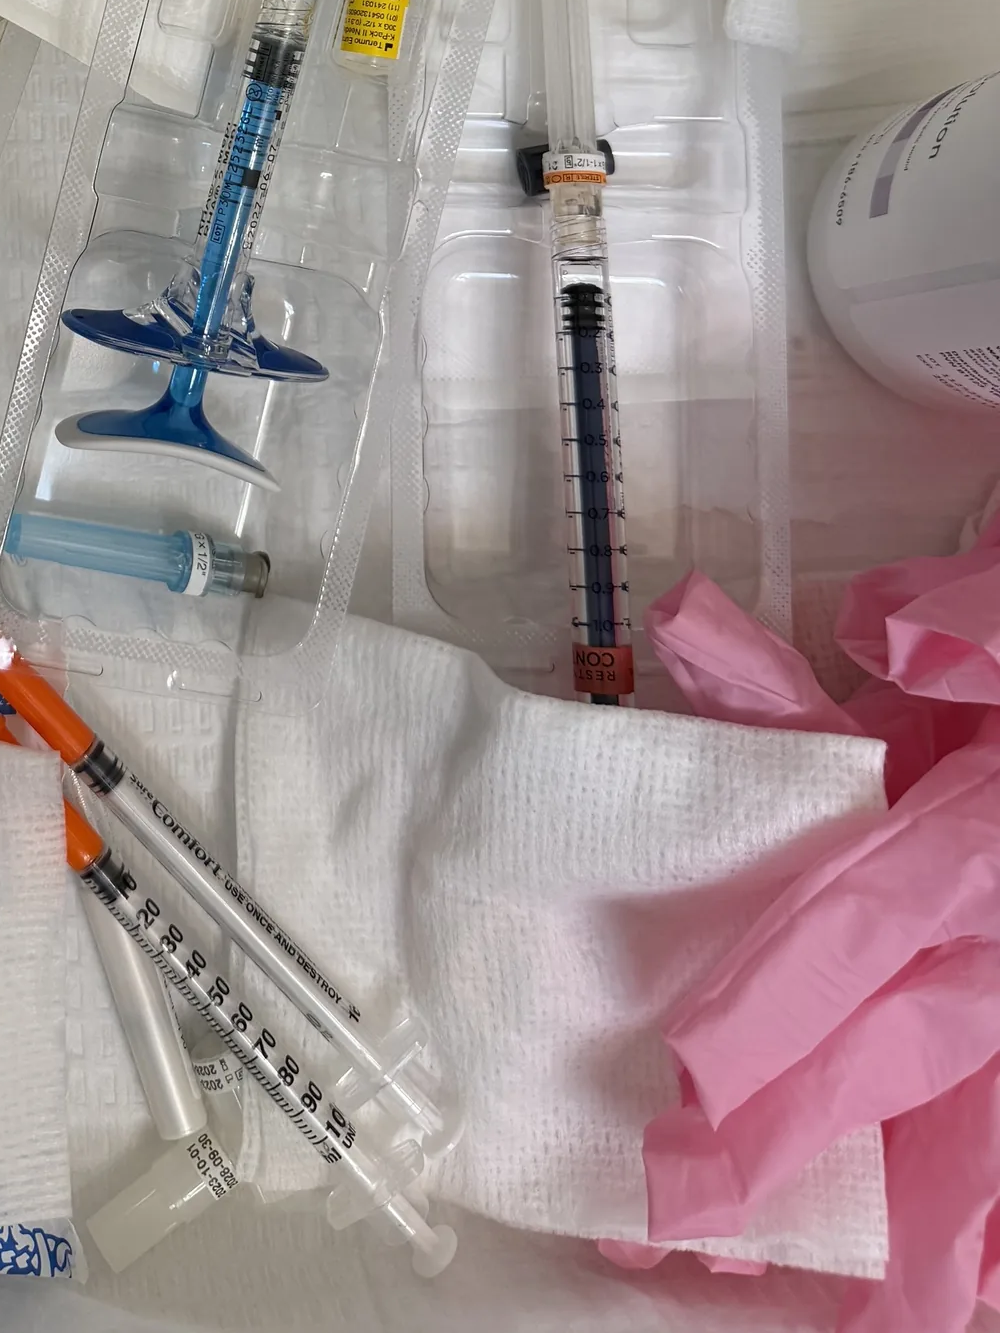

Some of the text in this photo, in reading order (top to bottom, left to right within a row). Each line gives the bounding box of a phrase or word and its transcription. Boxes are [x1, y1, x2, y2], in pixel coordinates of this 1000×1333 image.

[354, 38, 382, 49] Terumo
[370, 30, 395, 40] K-Pack
[928, 79, 986, 160] olution
[578, 326, 602, 338] 0.2
[580, 362, 603, 374] 0.3
[582, 398, 606, 410] 0.4
[584, 433, 608, 447] 0.5
[586, 470, 609, 483] 0.6
[588, 507, 610, 520] 0.7
[590, 544, 613, 557] 0.8
[591, 581, 615, 594] 0.9
[593, 619, 614, 632] 1.0
[152, 798, 222, 877] Comfort
[136, 897, 161, 930] 20
[160, 923, 184, 953] 30
[224, 879, 246, 905] USE
[245, 902, 275, 934] ONCE
[274, 932, 297, 957] AND
[296, 953, 342, 1004] DESTROY
[185, 949, 207, 978] 40
[207, 975, 230, 1007] 50
[230, 1001, 253, 1033] 60
[252, 1027, 276, 1060] 70
[277, 1054, 300, 1087] 80
[301, 1080, 323, 1114] 90
[325, 1103, 347, 1138] 10
